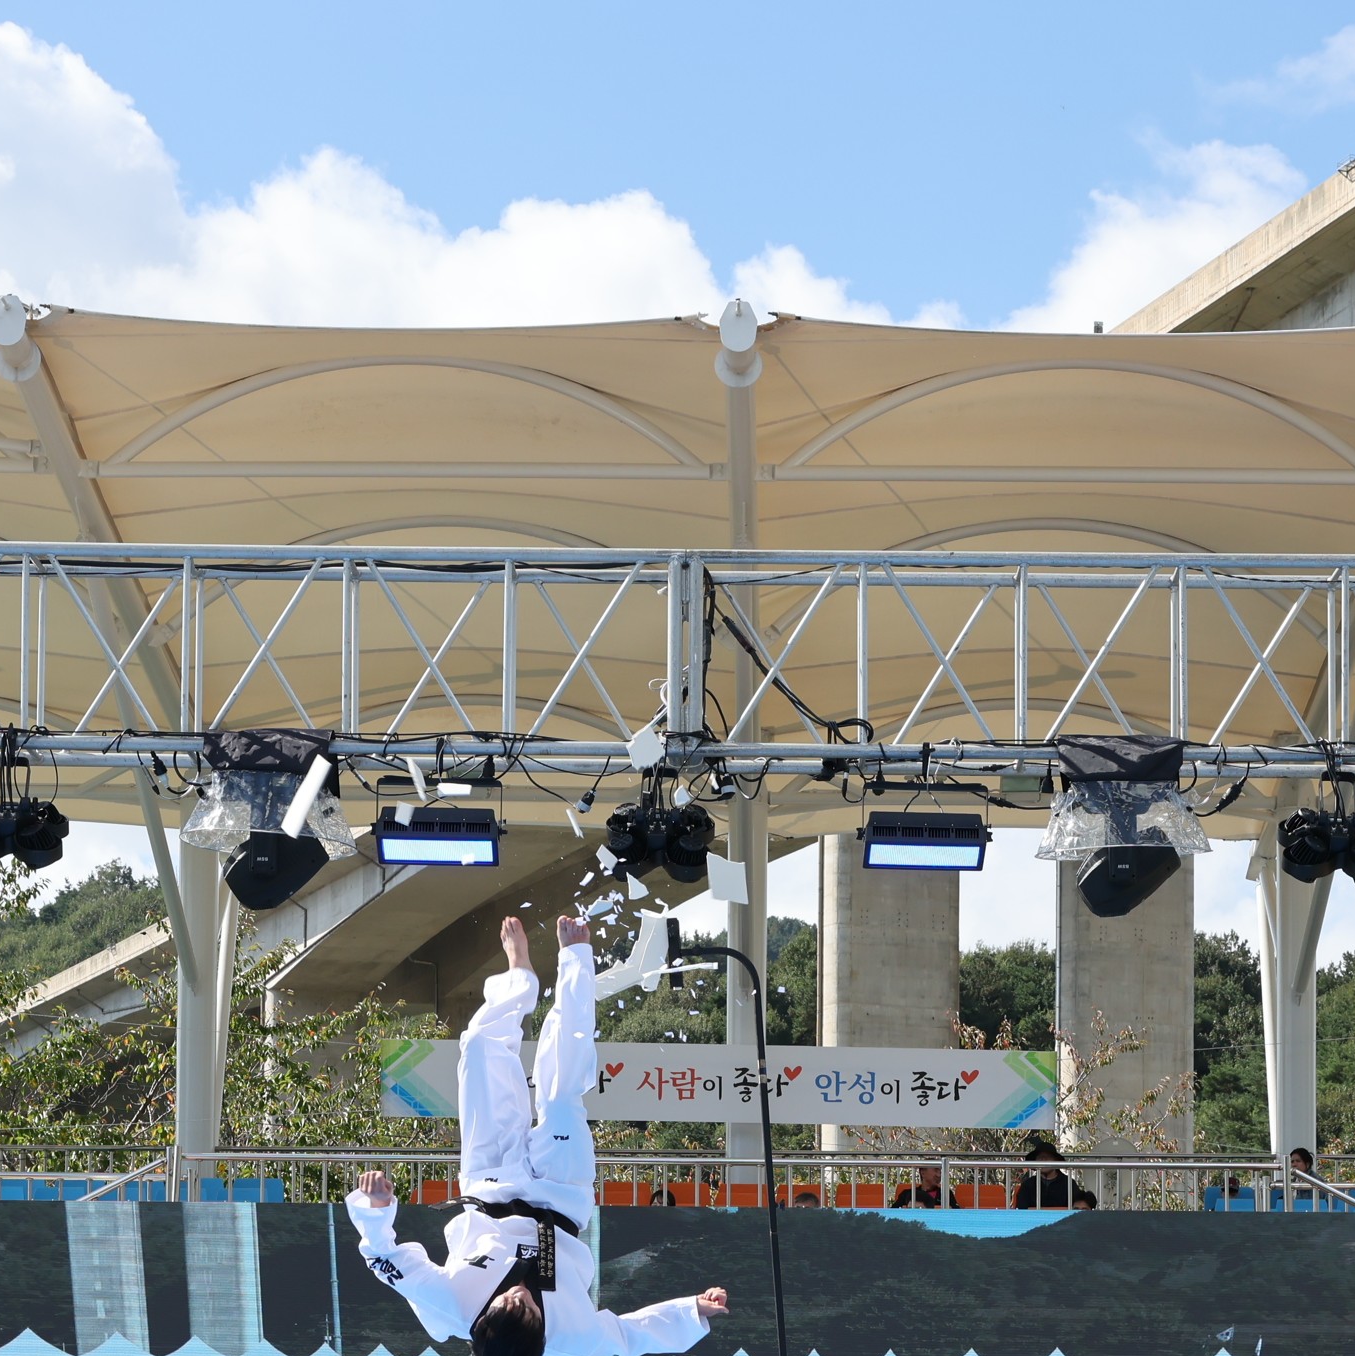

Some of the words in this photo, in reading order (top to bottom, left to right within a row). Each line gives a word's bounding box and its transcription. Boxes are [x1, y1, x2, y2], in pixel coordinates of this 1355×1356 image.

[636, 1067, 723, 1101] 사람이
[815, 1070, 902, 1104] 안성이
[910, 1071, 967, 1107] 좋다
